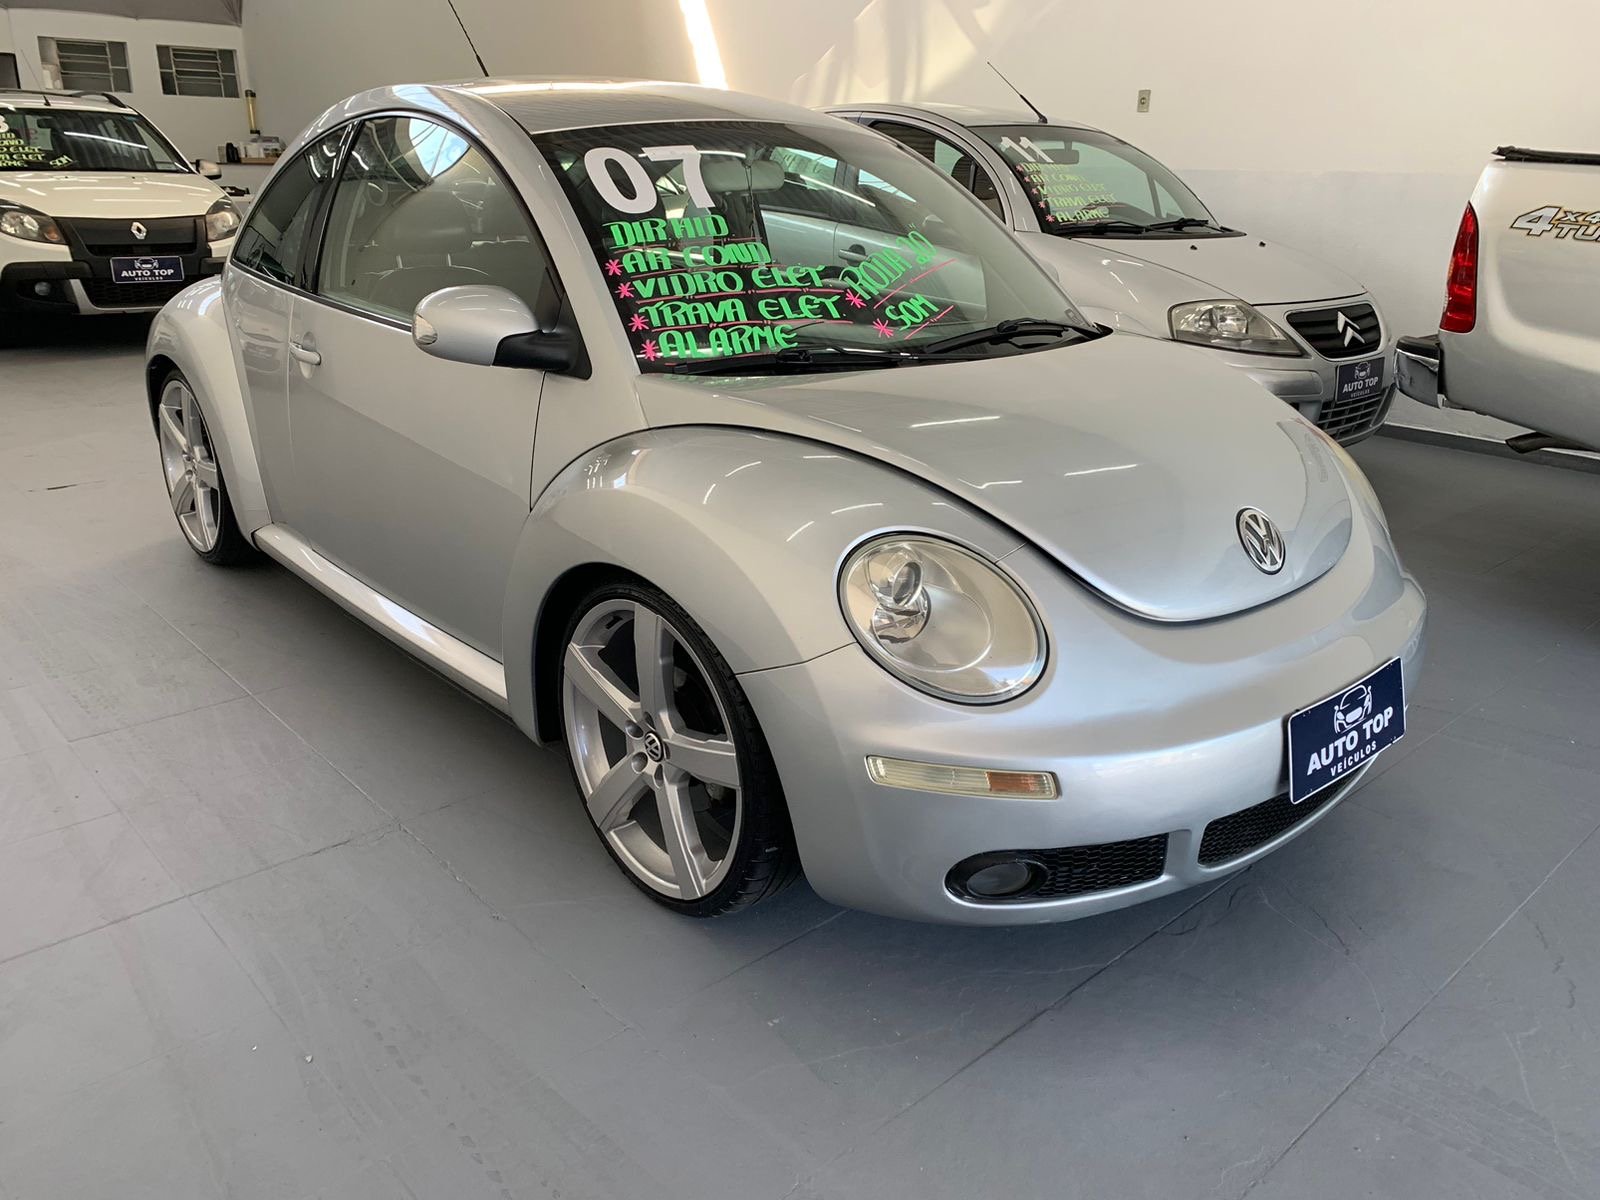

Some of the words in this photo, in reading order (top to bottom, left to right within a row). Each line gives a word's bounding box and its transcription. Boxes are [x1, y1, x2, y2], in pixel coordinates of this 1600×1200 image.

[1000, 136, 1055, 163] 11
[584, 145, 716, 214] 07
[121, 269, 150, 277] AUTO
[621, 246, 672, 274] AR
[632, 271, 744, 299] VIDRO
[638, 299, 748, 328] TRAVA
[885, 293, 940, 331] SOM
[658, 324, 799, 359] ALARME
[1342, 380, 1364, 393] AUTO
[1365, 377, 1379, 388] TOP
[1307, 730, 1359, 775] AUTO
[1363, 706, 1393, 739] TOP
[1330, 741, 1377, 776] VEÍCULOS
